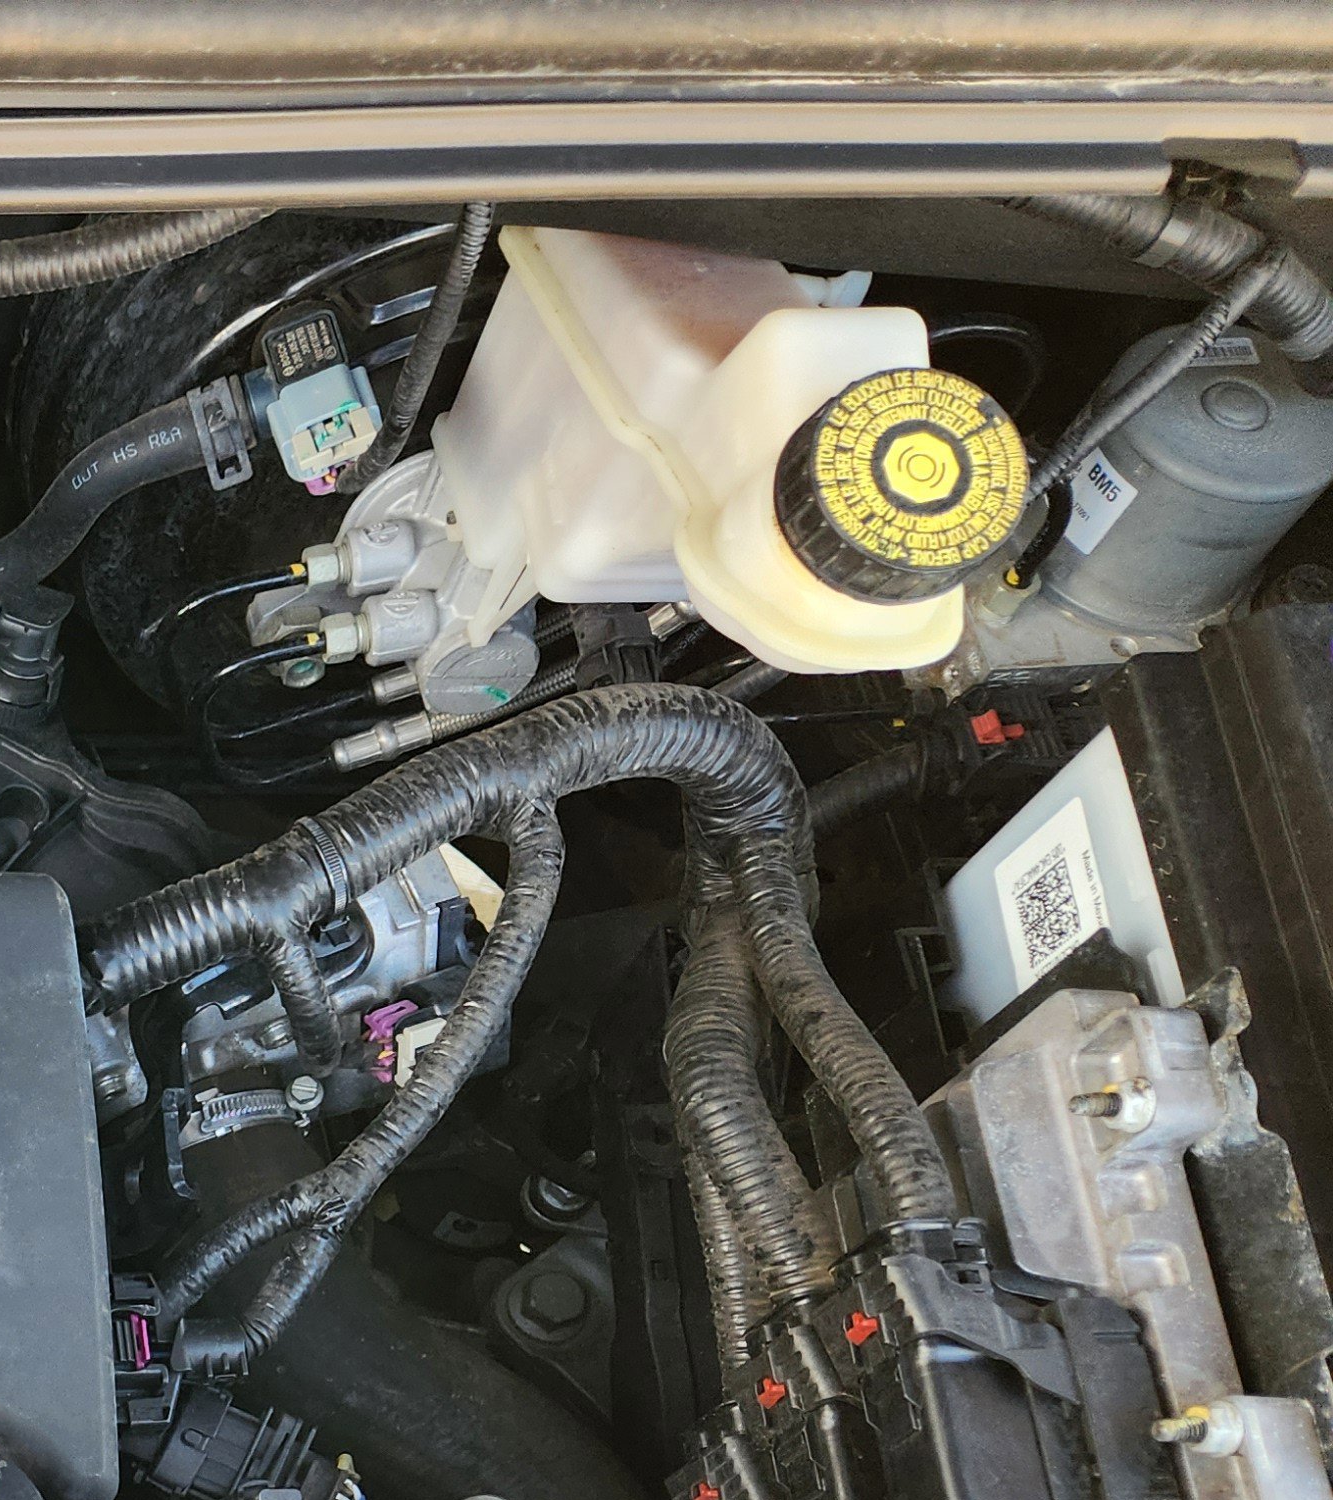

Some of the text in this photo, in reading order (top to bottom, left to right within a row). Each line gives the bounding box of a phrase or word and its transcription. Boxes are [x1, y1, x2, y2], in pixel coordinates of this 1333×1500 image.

[112, 442, 139, 464] HS
[148, 426, 183, 450] R&A
[1088, 462, 1122, 503] BM5
